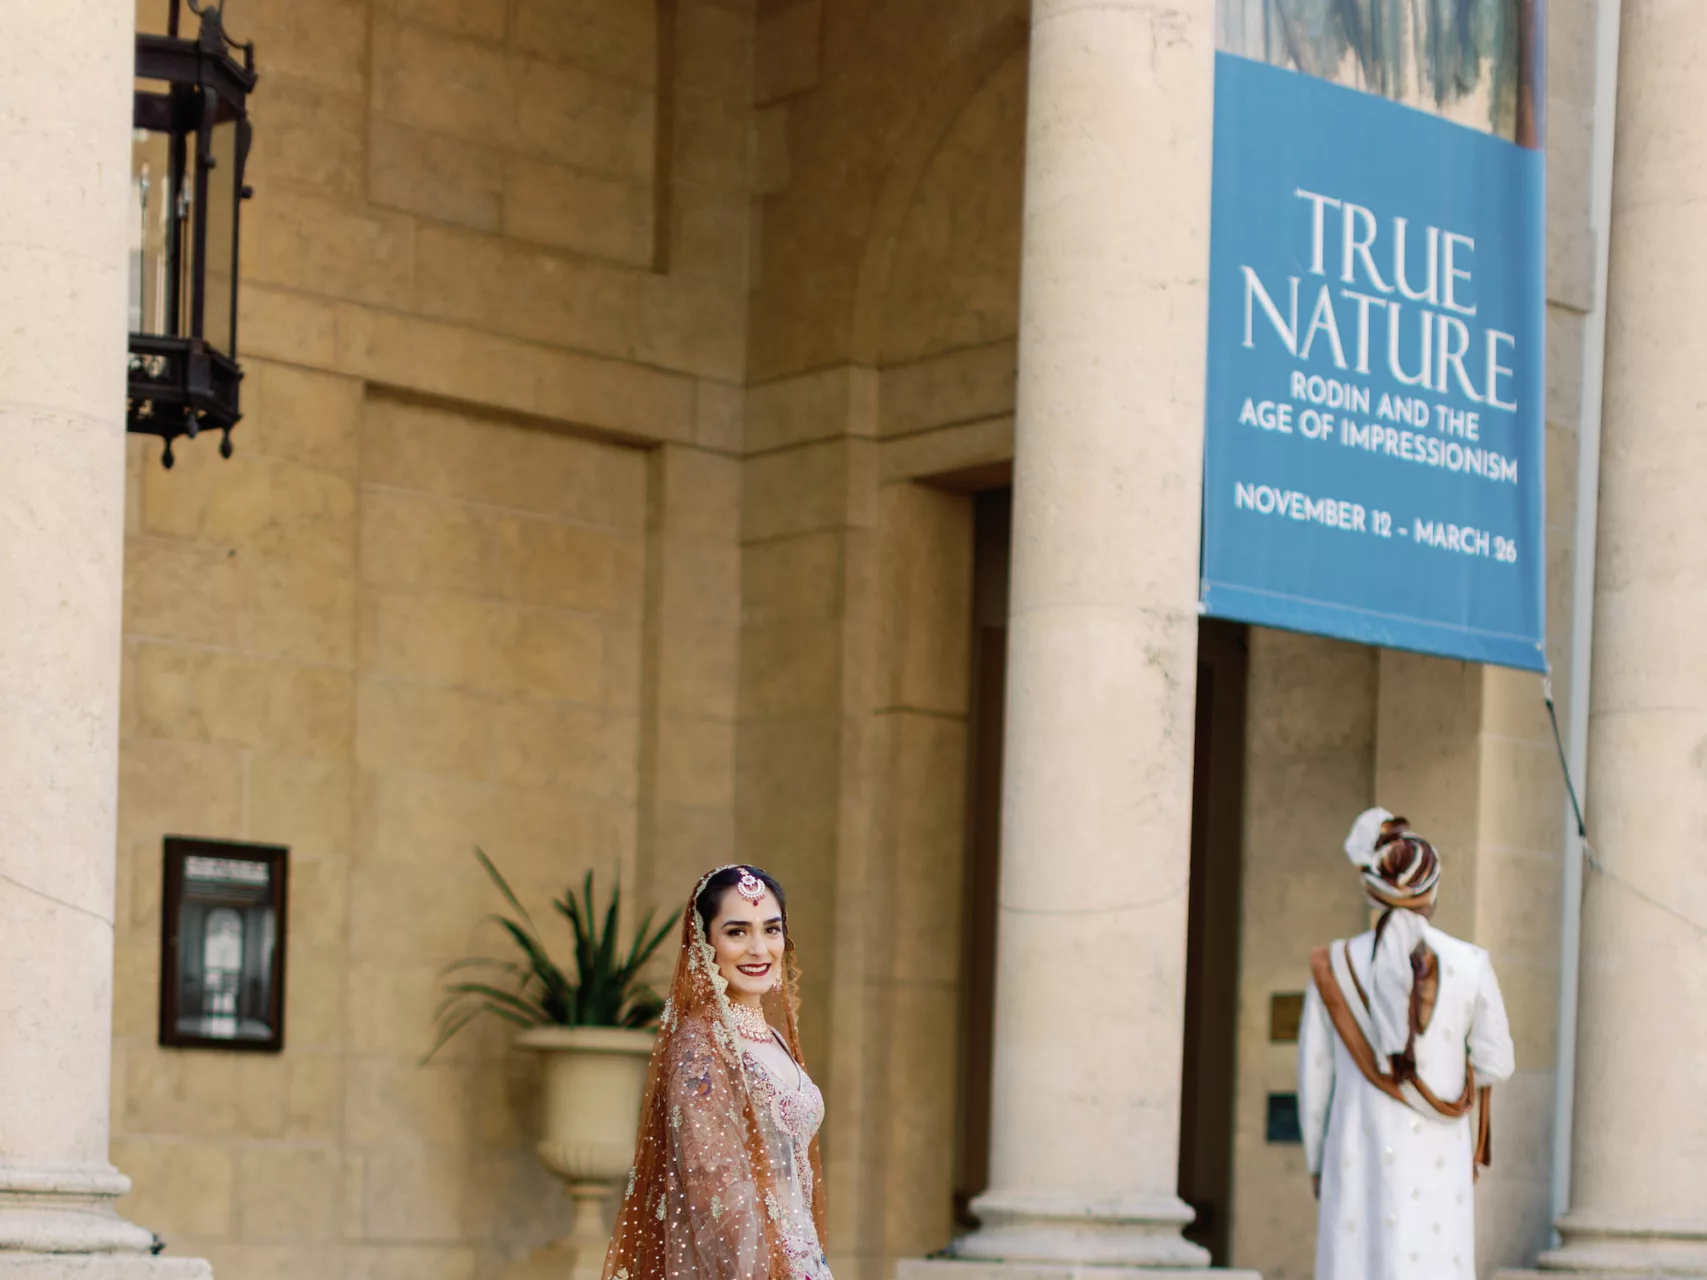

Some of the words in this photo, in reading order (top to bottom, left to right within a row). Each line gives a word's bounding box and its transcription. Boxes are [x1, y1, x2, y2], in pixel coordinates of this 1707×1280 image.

[1294, 187, 1476, 315] TRUE
[1240, 265, 1517, 413] NATURE
[1238, 398, 1293, 433] AGE
[1299, 410, 1334, 441] OF
[1340, 419, 1518, 484] IMPRESSIONISM
[1291, 370, 1370, 414] RODIN
[1376, 392, 1429, 427] AND
[1435, 406, 1479, 440] THE
[1234, 481, 1366, 533] NOVEMBER
[1371, 510, 1392, 538] 12
[1414, 518, 1490, 556] MARCH
[1493, 536, 1517, 563] 26
